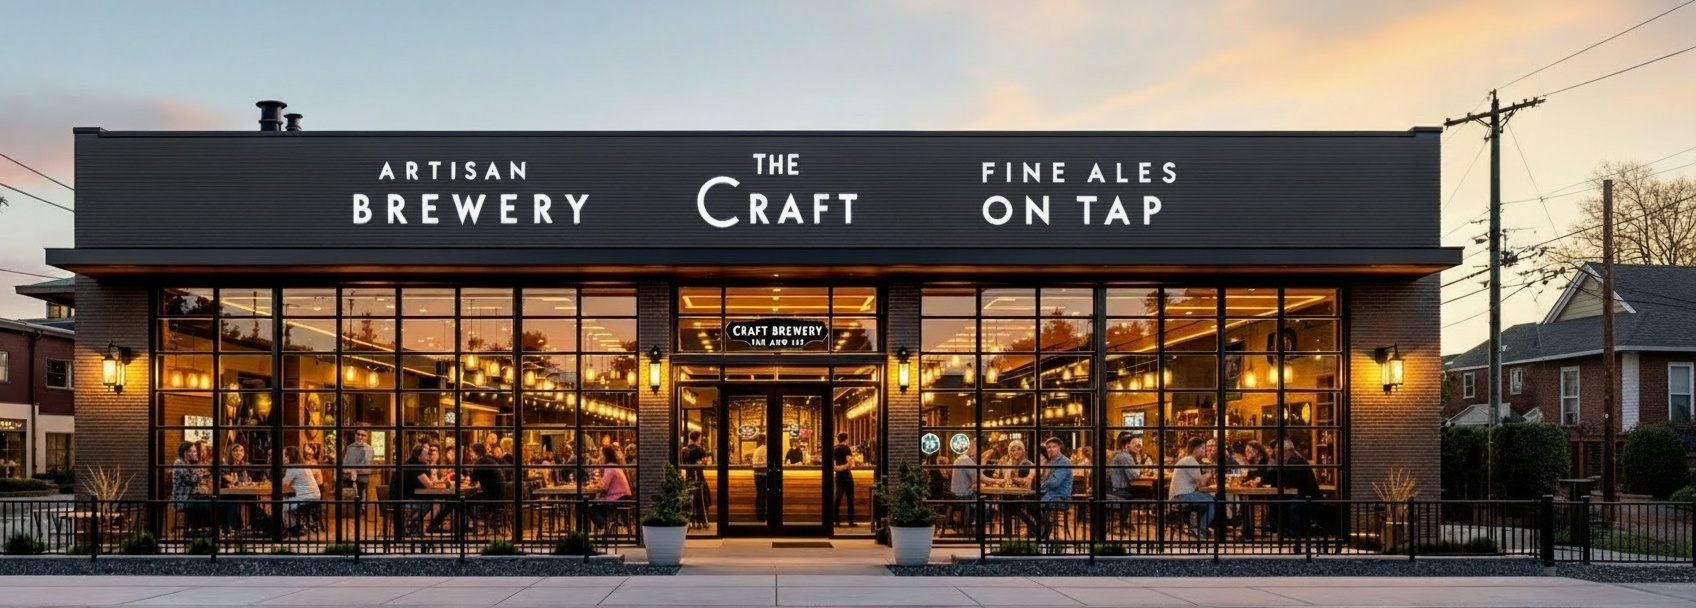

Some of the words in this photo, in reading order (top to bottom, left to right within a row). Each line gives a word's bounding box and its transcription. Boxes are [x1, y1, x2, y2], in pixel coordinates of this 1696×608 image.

[378, 160, 527, 181] ARTISAN
[752, 153, 800, 176] THE
[982, 161, 1066, 184] FINE
[1087, 161, 1177, 184] ALES
[352, 193, 590, 225] BREWERY
[696, 175, 859, 229] CRAFT
[982, 195, 1050, 226] ON
[1076, 195, 1163, 226] TAP
[732, 325, 768, 337] CRAFT
[772, 325, 823, 337] BREWERY
